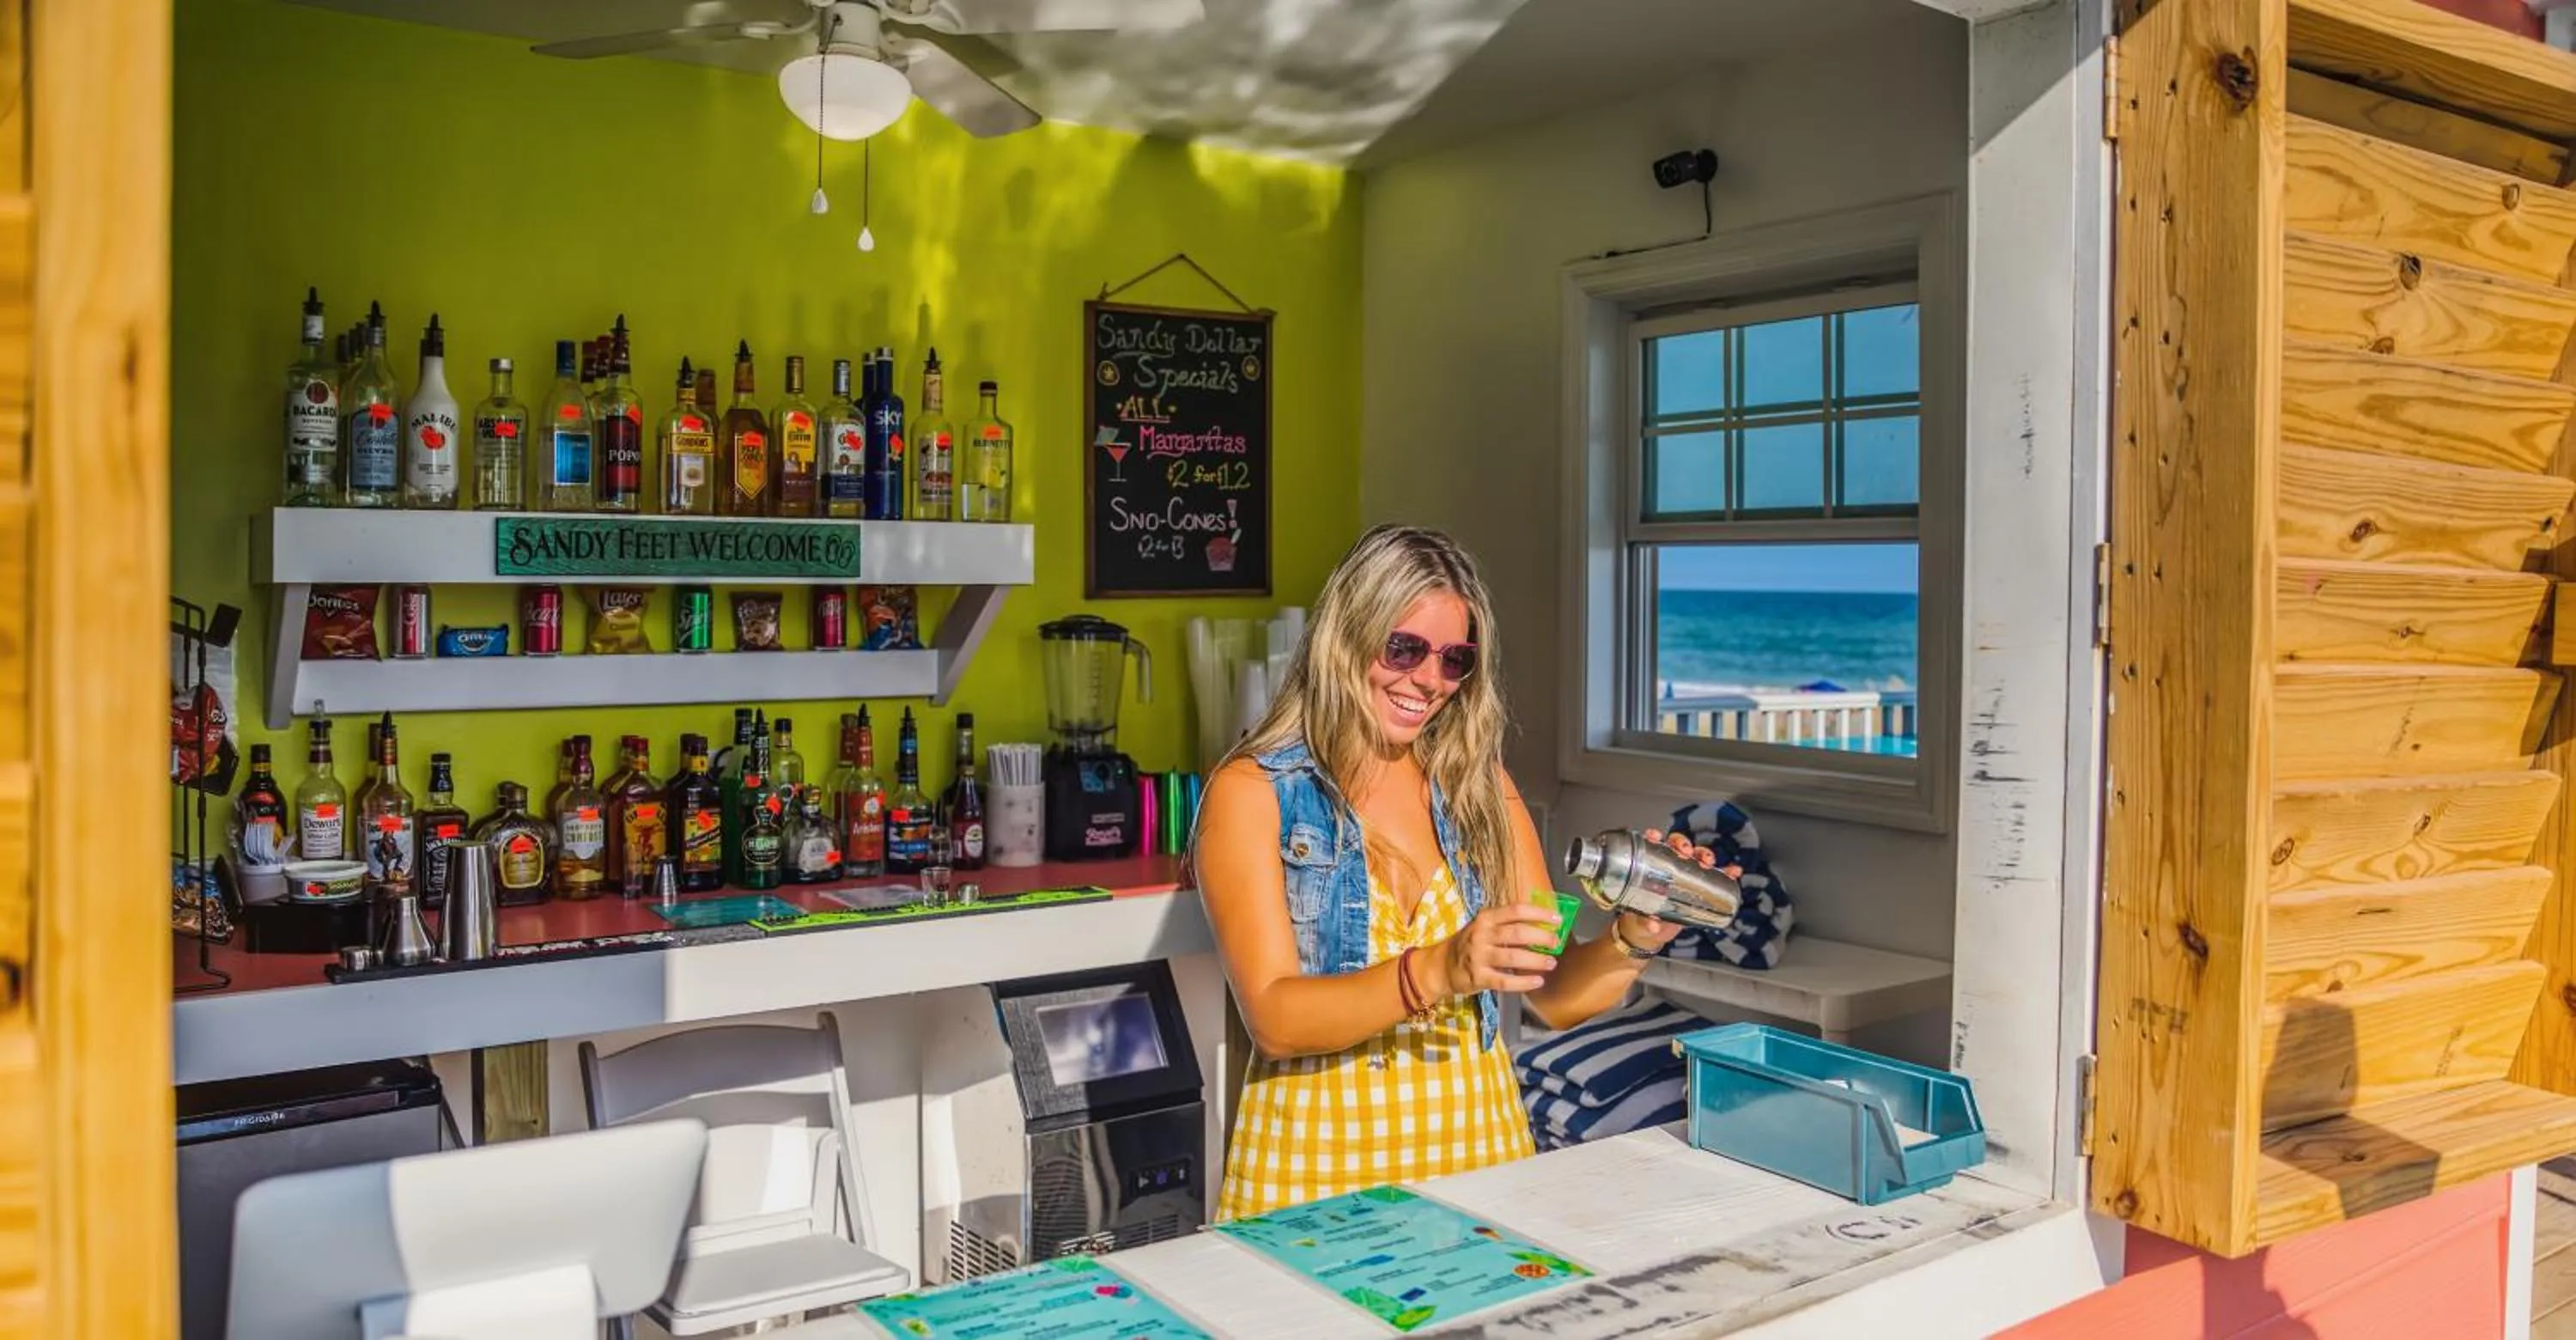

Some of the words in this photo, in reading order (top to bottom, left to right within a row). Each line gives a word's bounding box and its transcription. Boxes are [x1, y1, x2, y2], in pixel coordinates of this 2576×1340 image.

[1097, 314, 1177, 358] Sandy
[1184, 323, 1263, 354] Dollar
[1133, 354, 1238, 399] Specials
[1119, 394, 1171, 419] ALL
[1139, 426, 1247, 459] Margaritas
[509, 527, 611, 566] SANDY
[618, 527, 681, 560] FEET
[689, 531, 822, 563] WELCOME
